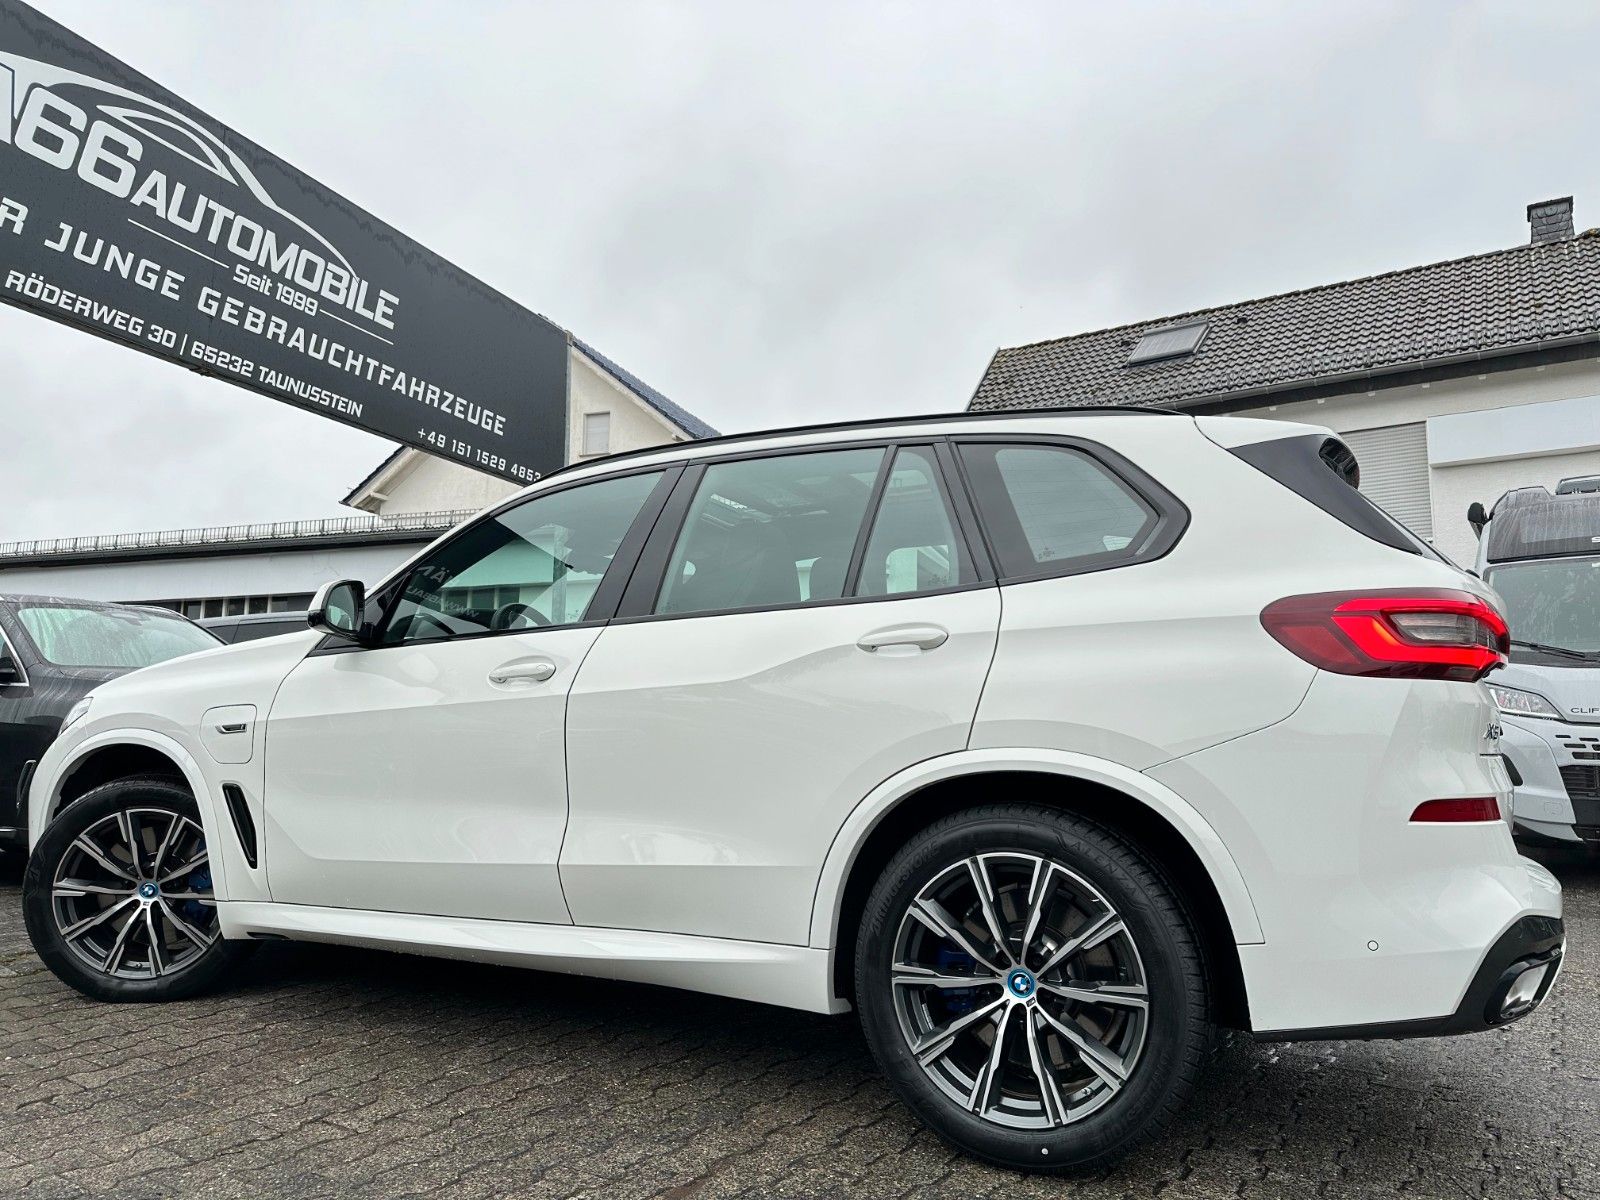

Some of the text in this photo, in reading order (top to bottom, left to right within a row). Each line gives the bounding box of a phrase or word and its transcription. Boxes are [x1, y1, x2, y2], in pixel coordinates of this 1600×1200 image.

[44, 222, 186, 301] JUNGE
[197, 286, 507, 436] GEBRAUCHTFAHRZEUGE
[233, 264, 319, 316] Seit 1999
[4, 269, 145, 337] RÖDERWEG
[147, 325, 177, 349] 30
[190, 340, 254, 378] 65232
[258, 365, 364, 418] TAUNUSSTEIN
[417, 428, 446, 448] +49
[452, 439, 472, 458] 151
[476, 449, 507, 471] 1529
